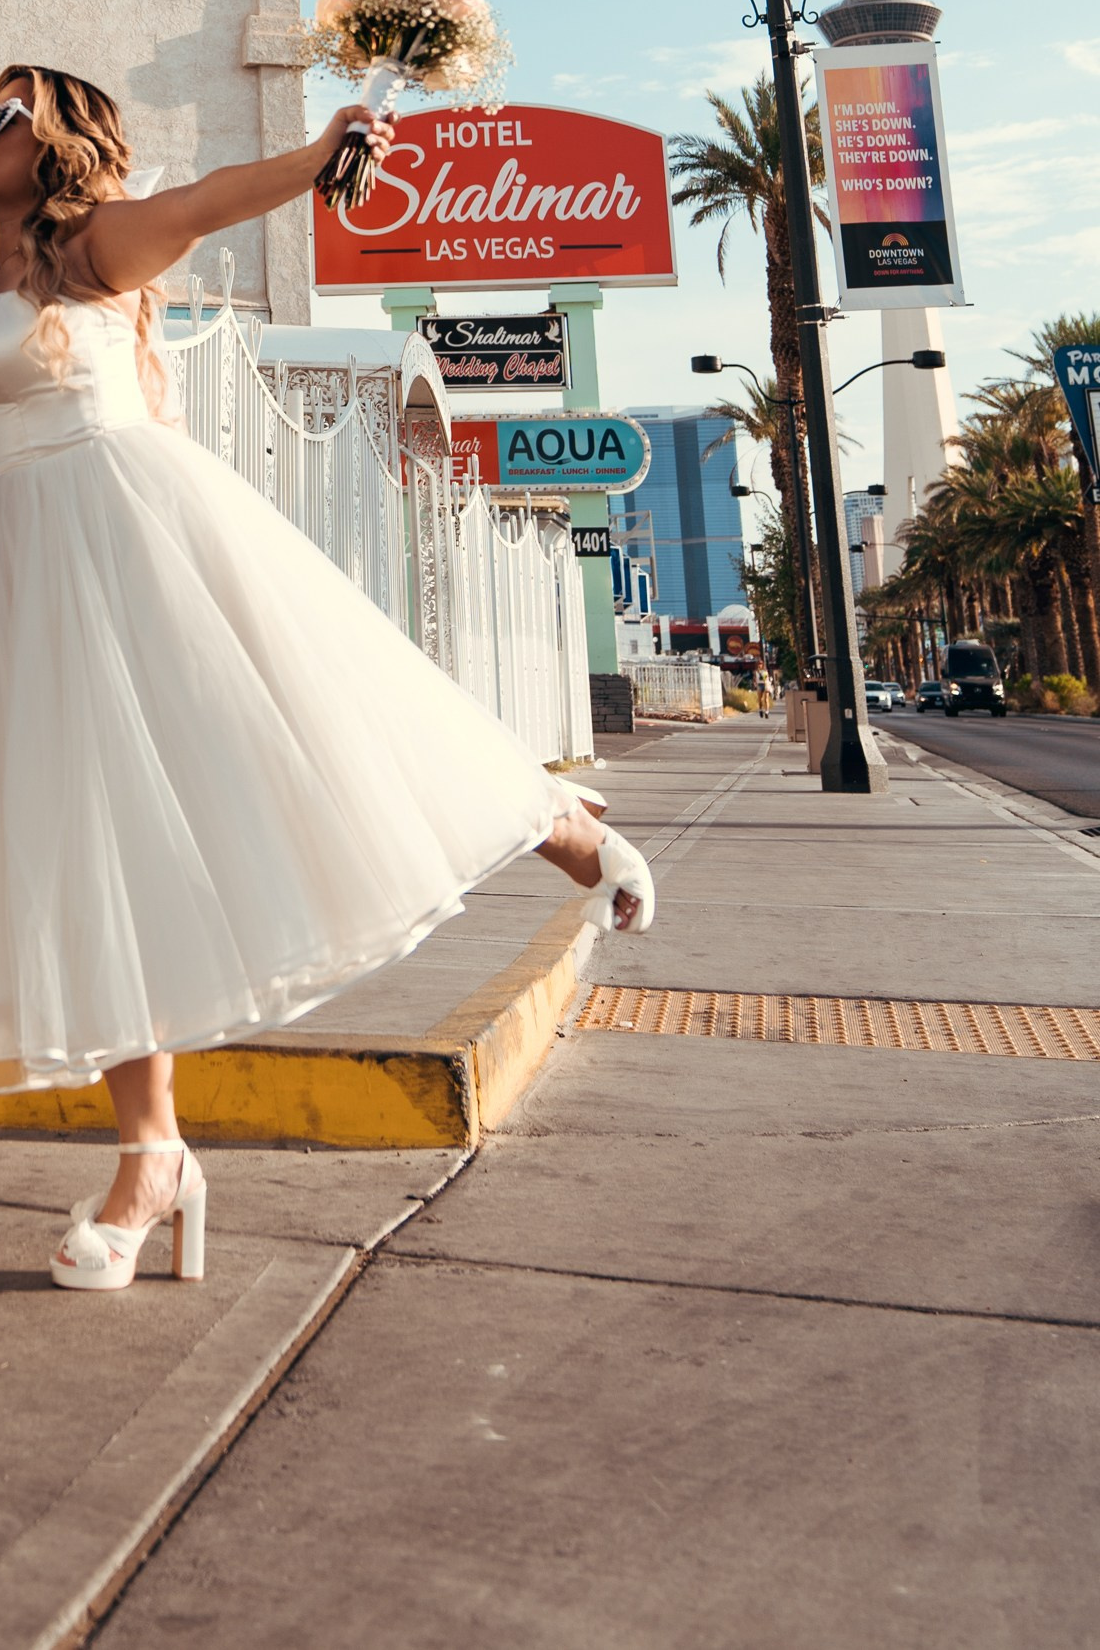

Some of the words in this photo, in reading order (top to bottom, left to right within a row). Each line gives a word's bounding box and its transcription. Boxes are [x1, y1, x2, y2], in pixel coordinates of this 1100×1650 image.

[833, 103, 854, 116] I'M
[856, 102, 900, 116] DOWN.
[835, 119, 869, 132] SHE'S
[872, 117, 916, 131] DOWN.
[435, 120, 533, 149] HOTEL
[837, 135, 864, 148] HE'S
[866, 134, 911, 147] DOWN.
[838, 151, 887, 164] THEY'RE
[889, 148, 933, 163] DOWN.
[337, 143, 641, 236] Shalimar
[841, 178, 883, 191] WHO'S
[885, 176, 933, 190] DOWN?
[425, 239, 468, 261] LAS
[473, 236, 555, 260] VEGAS
[868, 249, 925, 259] DOWNTOWN
[877, 258, 892, 266] LAS
[893, 257, 918, 266] VEGAS
[444, 321, 542, 347] Shalimar
[435, 355, 499, 384] Wedding
[503, 352, 560, 382] Chapel
[507, 428, 626, 465] AQUA
[508, 468, 556, 476] BREAKFAST
[562, 467, 590, 475] LUNCH
[595, 467, 627, 475] DINNER
[573, 532, 608, 552] 1401
